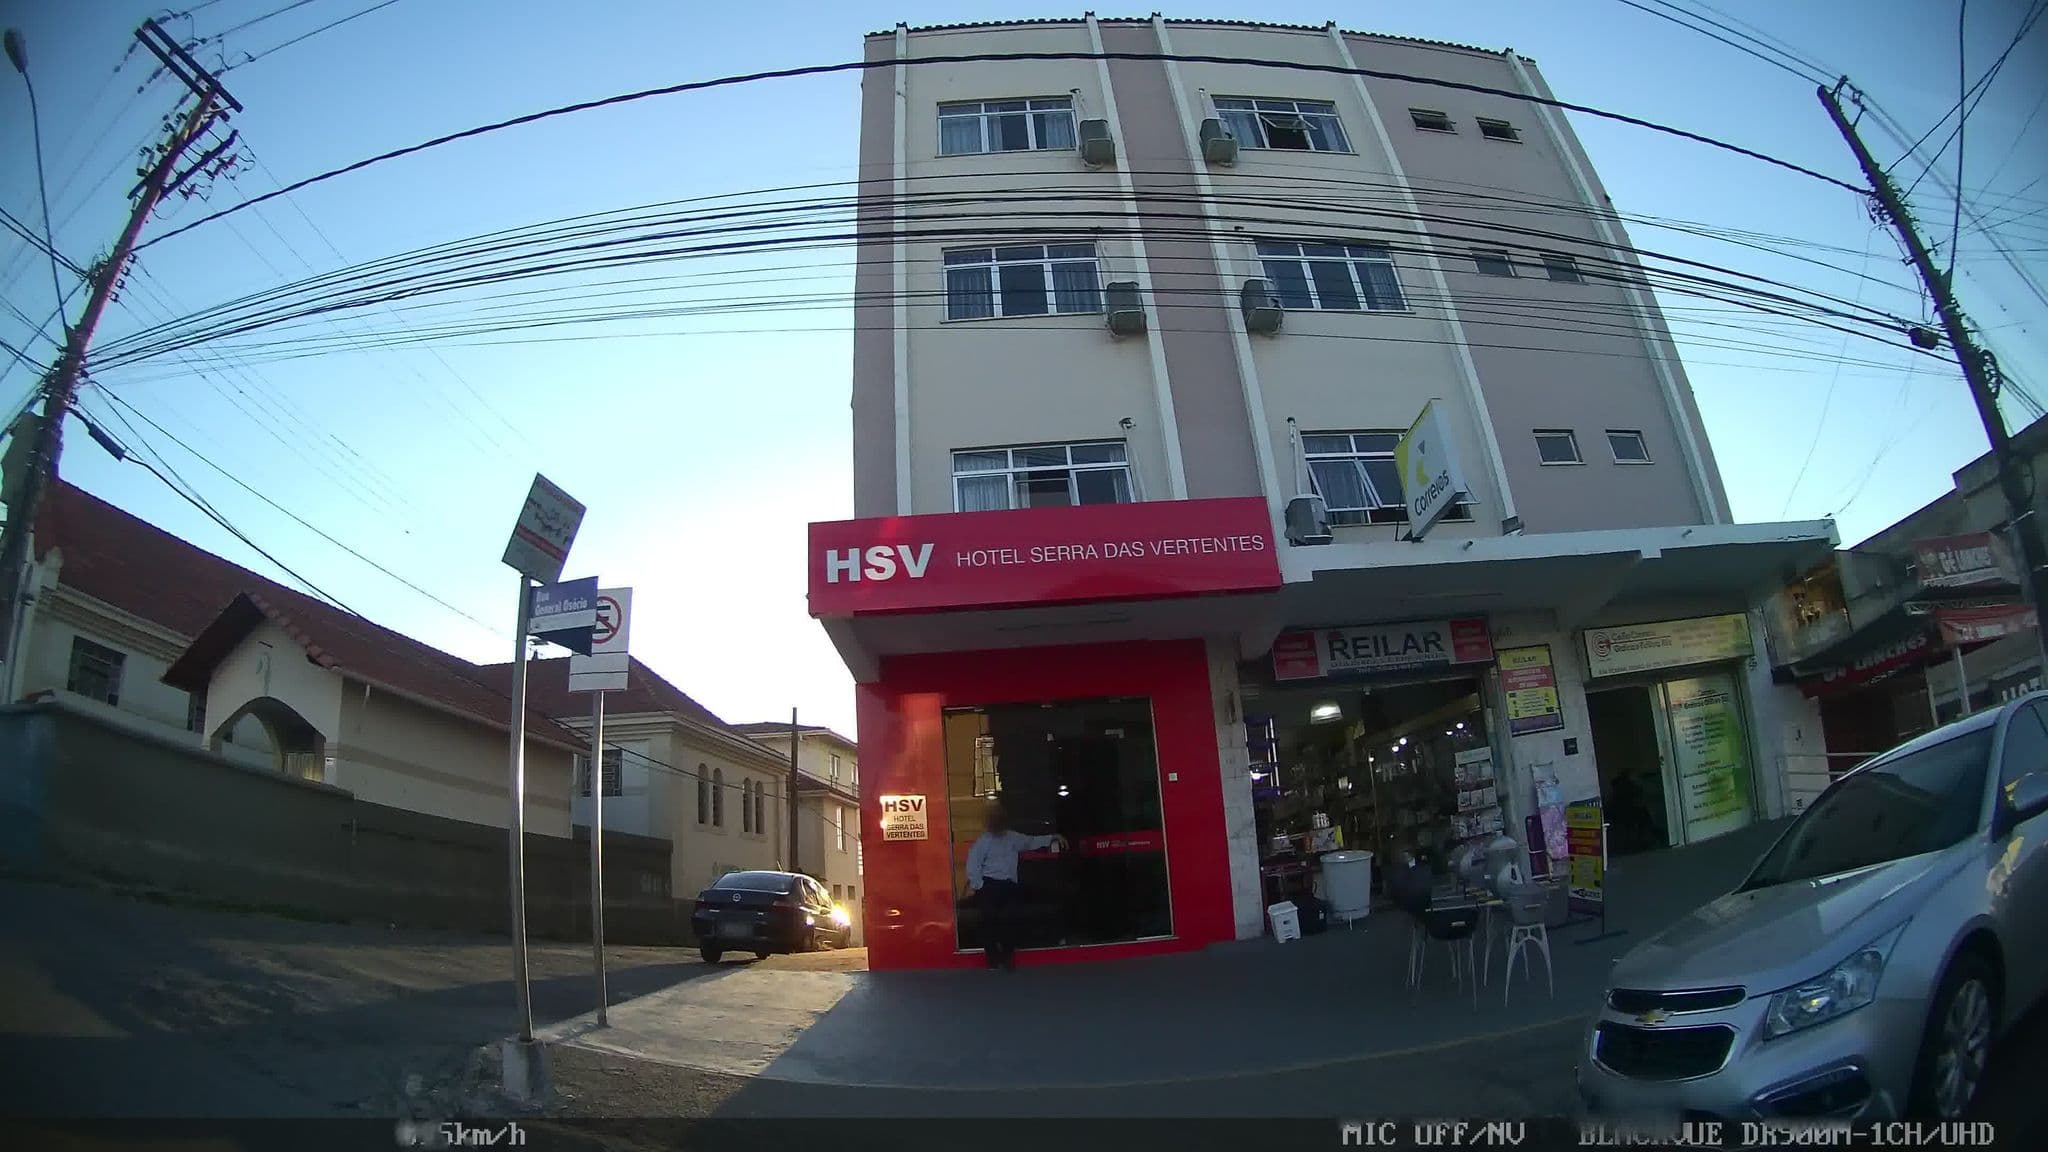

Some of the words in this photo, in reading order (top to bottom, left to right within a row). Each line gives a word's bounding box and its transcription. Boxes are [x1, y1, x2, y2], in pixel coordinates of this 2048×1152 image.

[1414, 470, 1449, 516] Correios
[826, 543, 935, 584] HSV
[956, 547, 1026, 568] HOTEL
[1029, 544, 1099, 564] SERRA
[1104, 541, 1145, 559] DAS
[1151, 534, 1265, 557] VERTENTES
[1328, 631, 1445, 660] REILAR
[885, 799, 923, 812] HSV
[886, 831, 926, 839] VERTENTES
[909, 823, 925, 831] DAS
